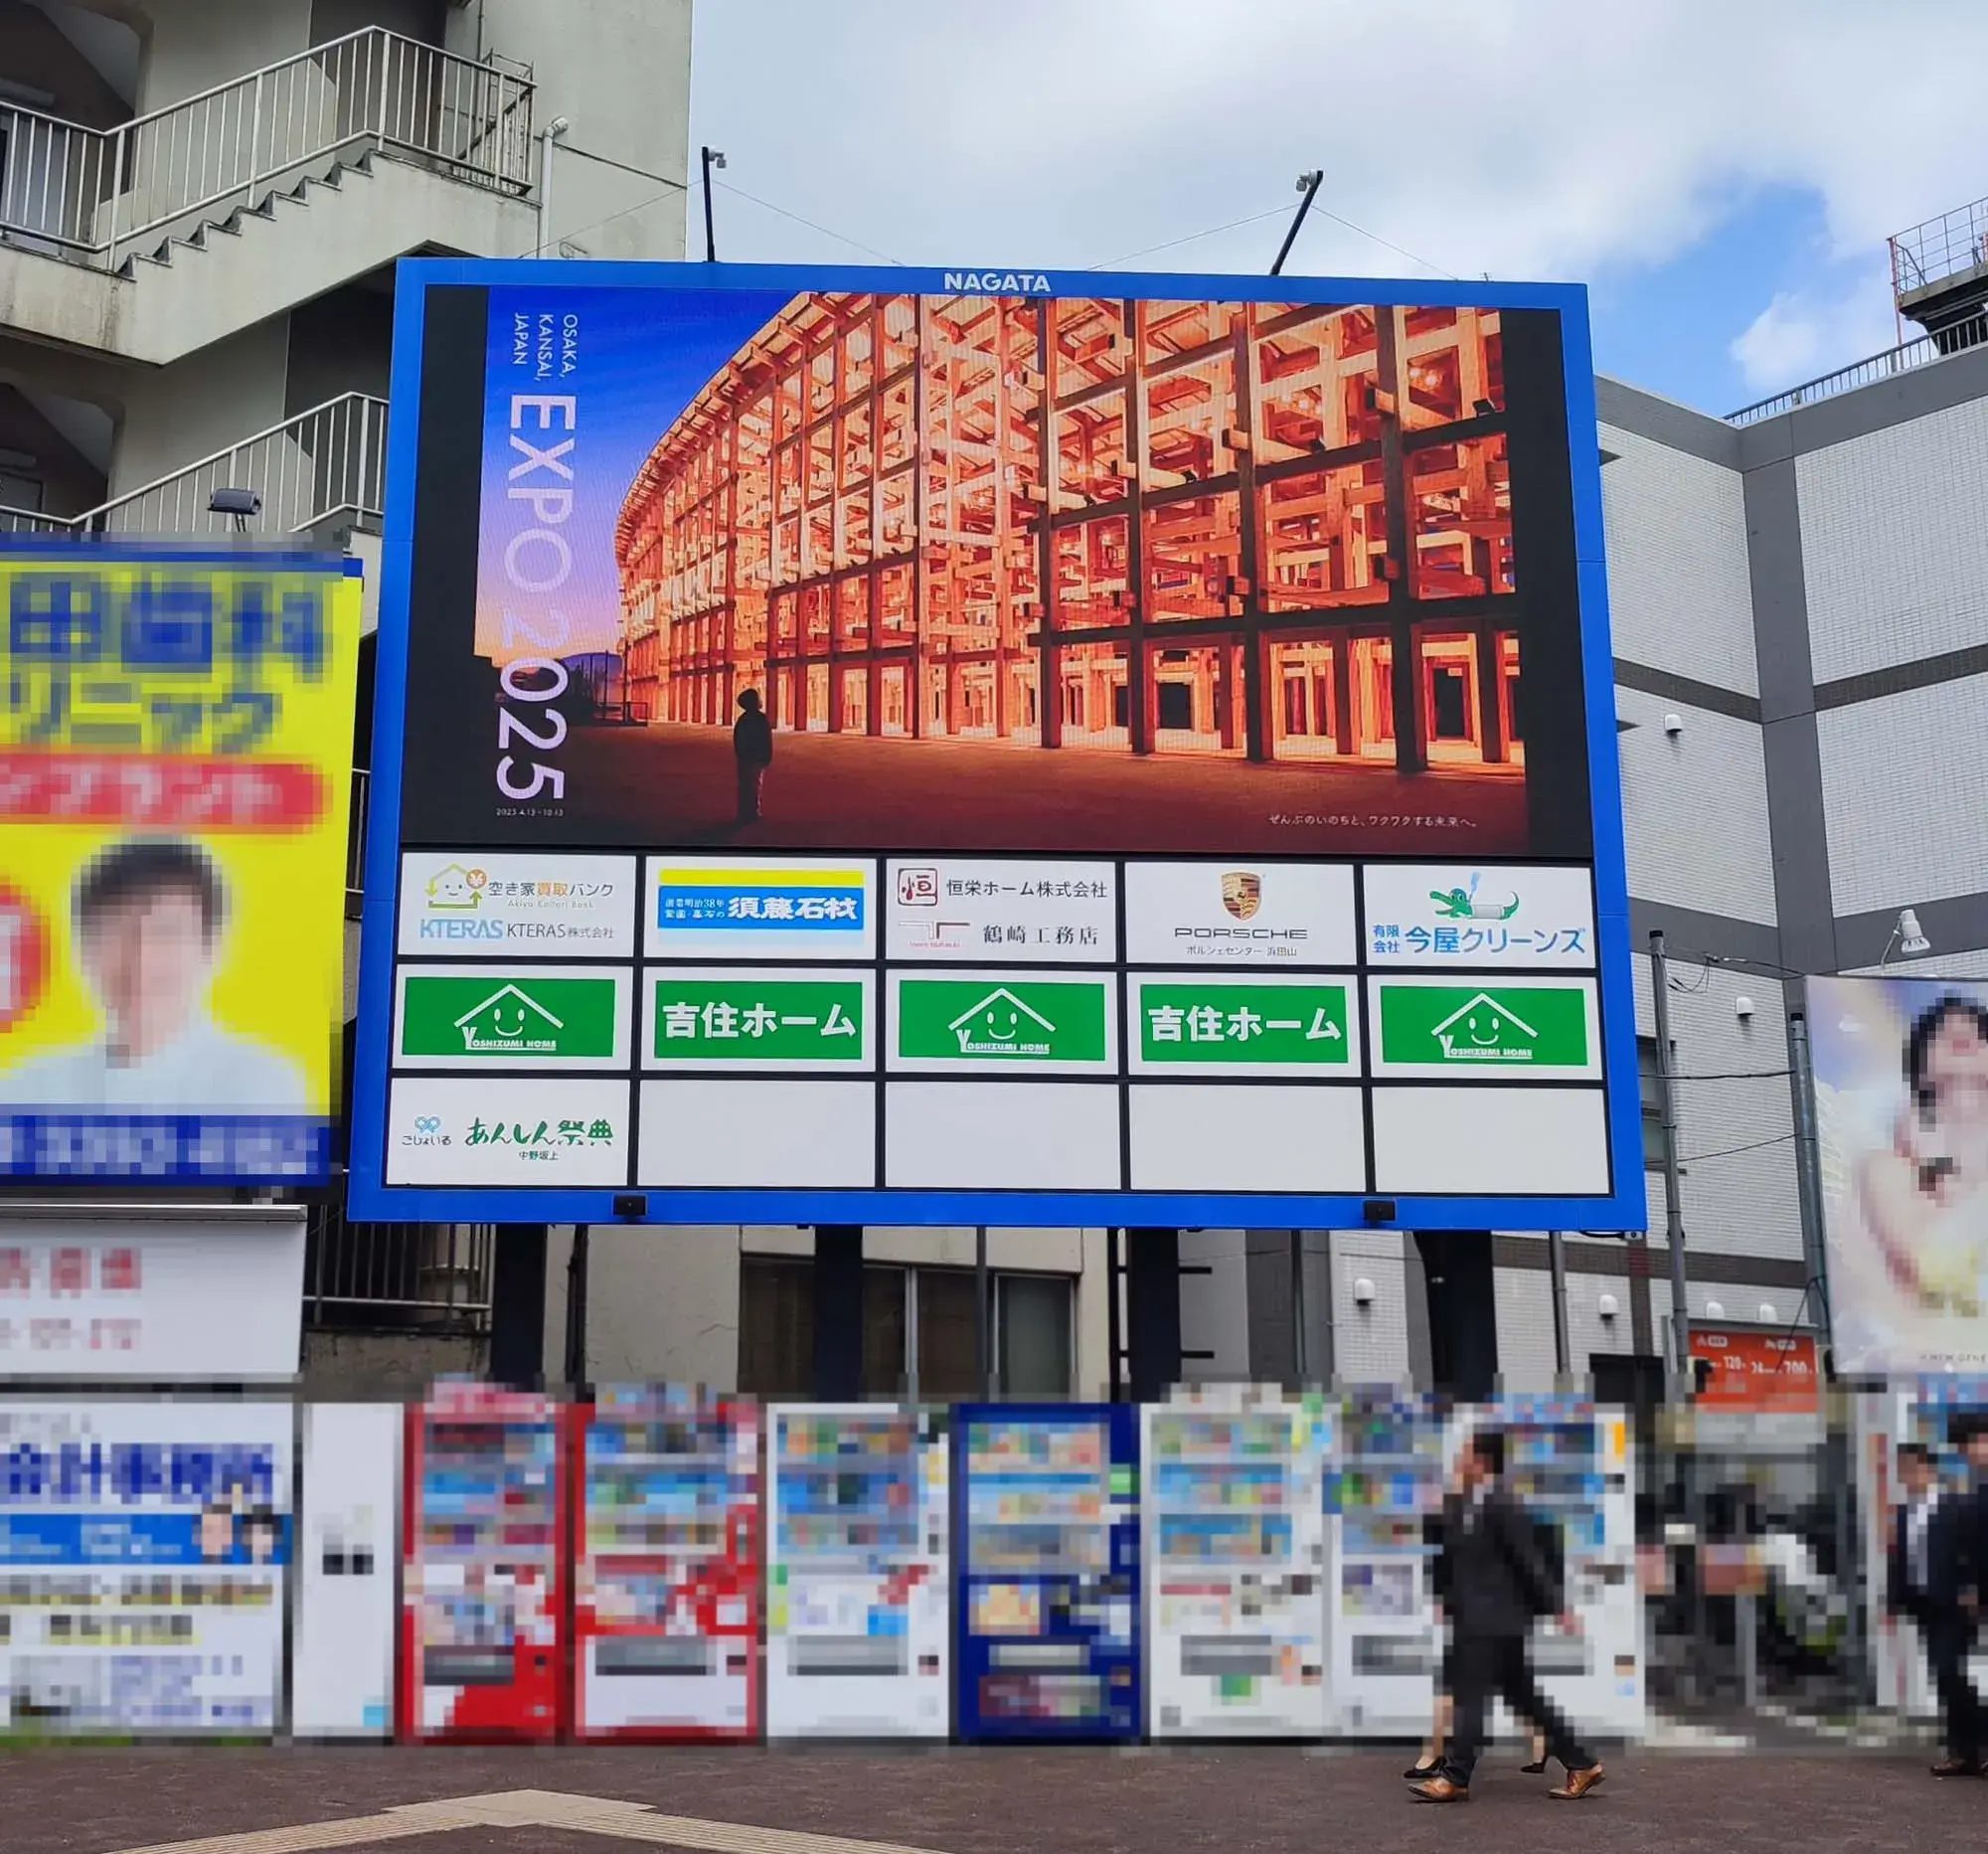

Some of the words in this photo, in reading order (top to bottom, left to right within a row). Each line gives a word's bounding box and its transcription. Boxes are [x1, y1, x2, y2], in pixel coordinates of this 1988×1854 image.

[944, 272, 1052, 292] NAGATA
[513, 312, 529, 365] JAPAN
[534, 314, 554, 382] KANSAI,
[559, 314, 578, 378] OSAKA,
[505, 394, 577, 593] EXPO
[496, 605, 572, 799] 2025
[488, 881, 614, 897] 空き家買取バンク
[946, 880, 1108, 899] 恒栄ホーム株式会社
[420, 919, 504, 939] KTERAS
[982, 924, 1098, 945] 鶴崎工務店
[1174, 927, 1308, 939] PORSCHE
[1373, 925, 1400, 937] 有限
[1405, 926, 1586, 953] 今屋クリーンズ
[1373, 940, 1400, 954] 会社
[663, 1002, 857, 1039] 吉住ホーム
[1147, 1005, 1342, 1042] 吉住ホーム
[464, 1116, 614, 1146] あんしん祭典
